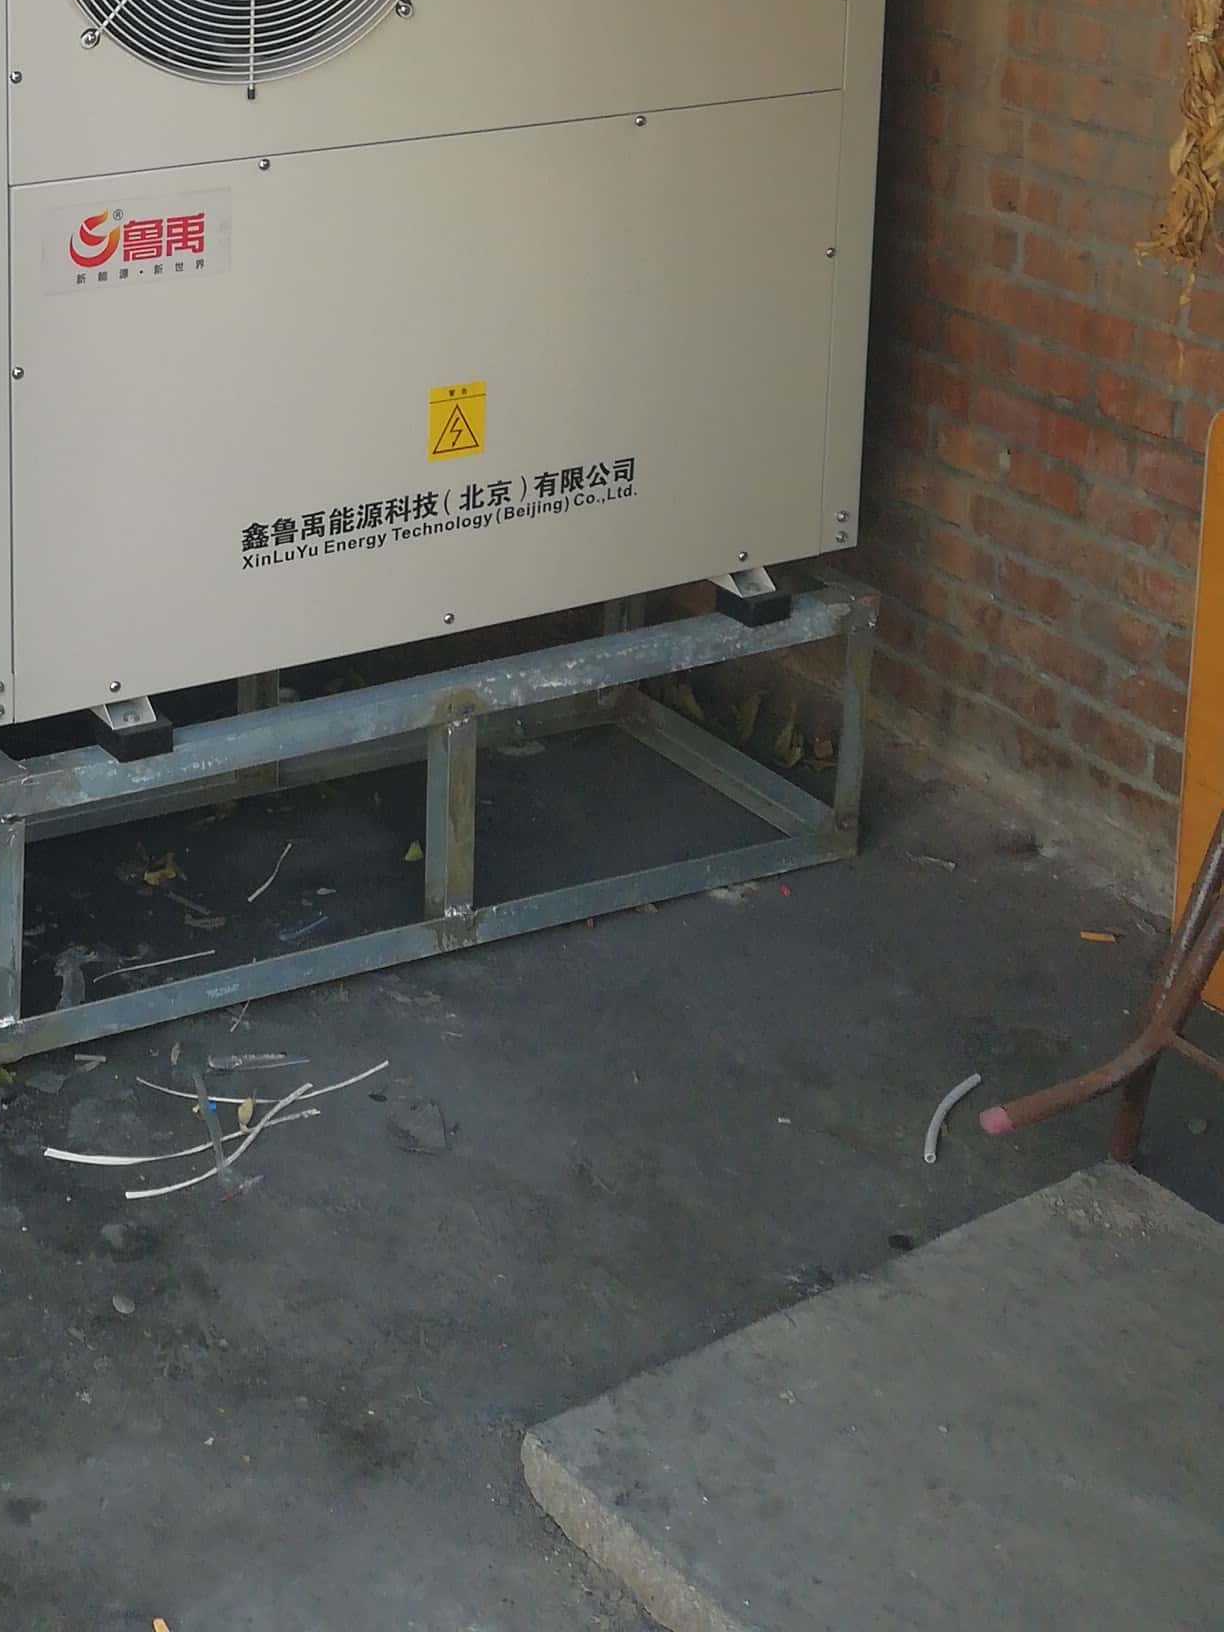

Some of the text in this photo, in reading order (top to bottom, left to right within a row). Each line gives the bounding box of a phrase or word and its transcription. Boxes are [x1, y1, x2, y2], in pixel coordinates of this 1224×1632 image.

[123, 213, 205, 262] 鲁禹
[241, 457, 636, 553] 鑫鲁禹能源科技（北京）有限公司
[242, 544, 319, 570] XinLuYu
[324, 533, 387, 554] Energy
[392, 513, 493, 542] Technology
[574, 484, 638, 507] Co.,Ltd.
